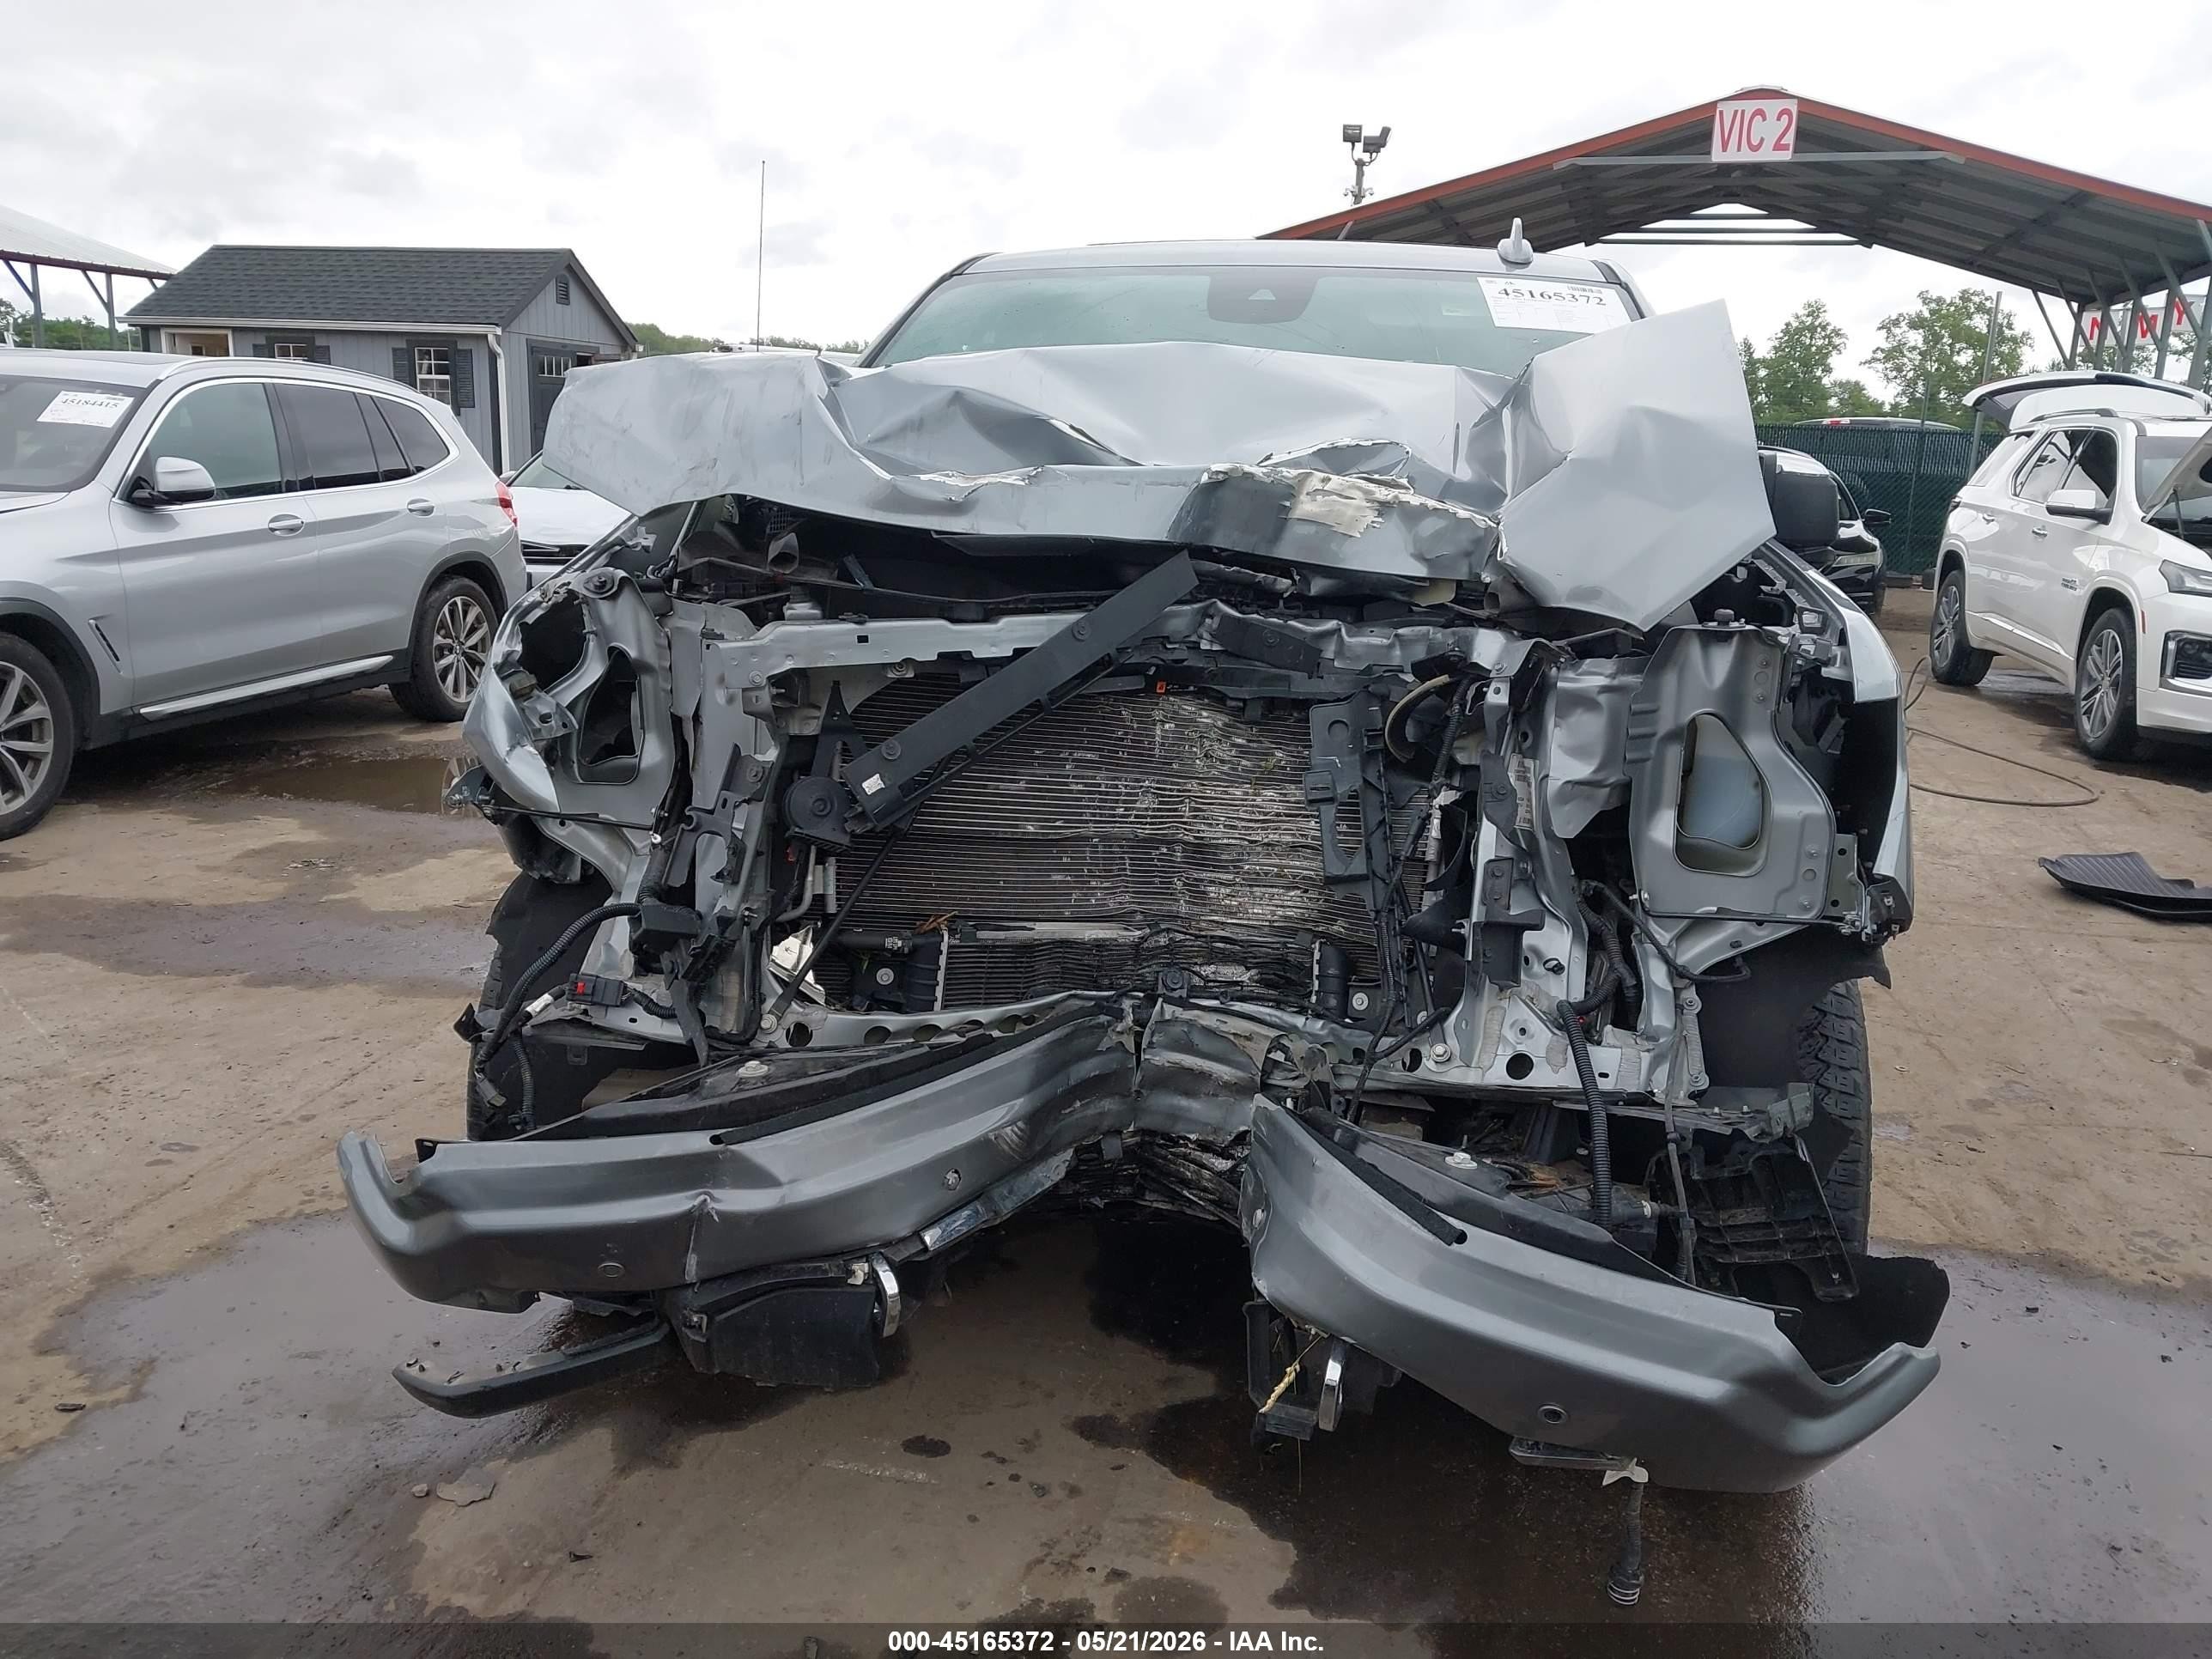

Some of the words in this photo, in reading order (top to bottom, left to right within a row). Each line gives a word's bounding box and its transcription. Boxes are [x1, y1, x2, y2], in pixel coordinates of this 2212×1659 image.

[1718, 107, 1767, 153] VIC
[1771, 107, 1794, 152] 2
[1498, 288, 1606, 306] 45165372
